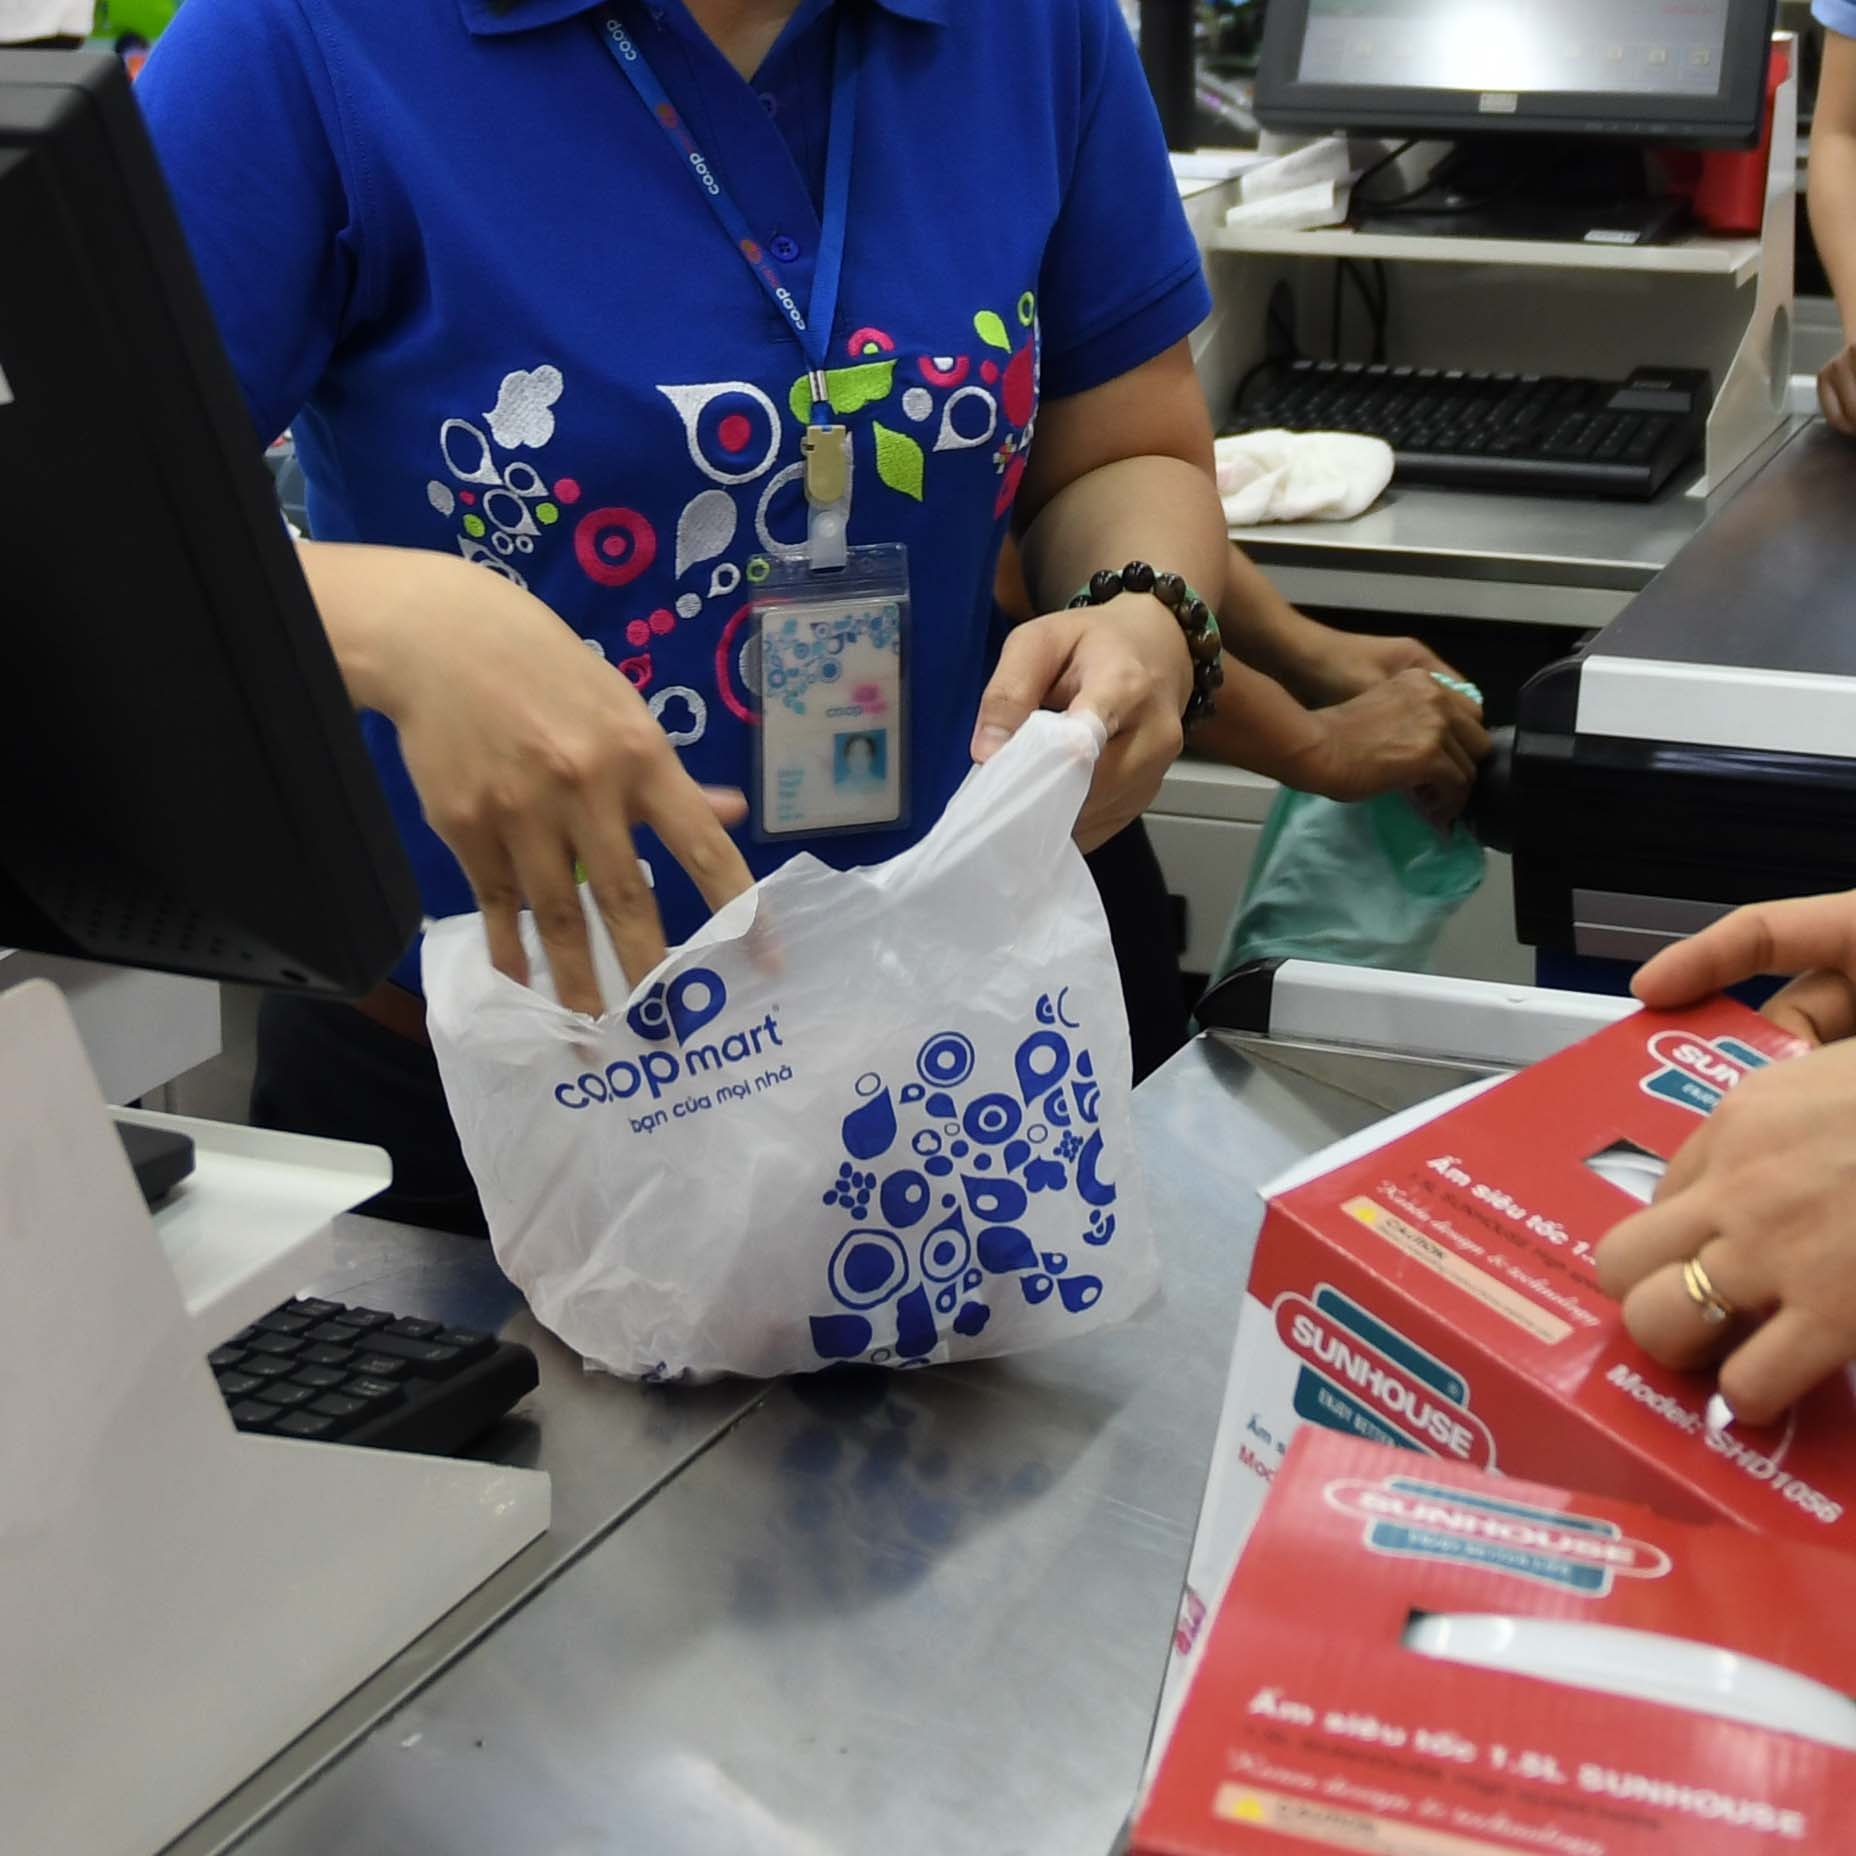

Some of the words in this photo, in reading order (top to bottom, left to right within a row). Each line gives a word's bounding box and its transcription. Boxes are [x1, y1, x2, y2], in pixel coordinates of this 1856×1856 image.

[627, 1103, 671, 1135] bạn
[672, 1094, 713, 1123] của
[715, 1079, 753, 1113] mọi
[755, 1063, 795, 1099] nhà
[1471, 1183, 1528, 1221] siêu
[1524, 1214, 1570, 1245] tốc
[1291, 1313, 1475, 1460] SUNHOUSE
[1359, 1492, 1636, 1567] SUNHOUSE
[1249, 1684, 1315, 1729] Ấm
[1323, 1706, 1408, 1749] siêu
[1413, 1725, 1478, 1764] tốc
[1576, 1762, 1806, 1839] SUNHOUSE
